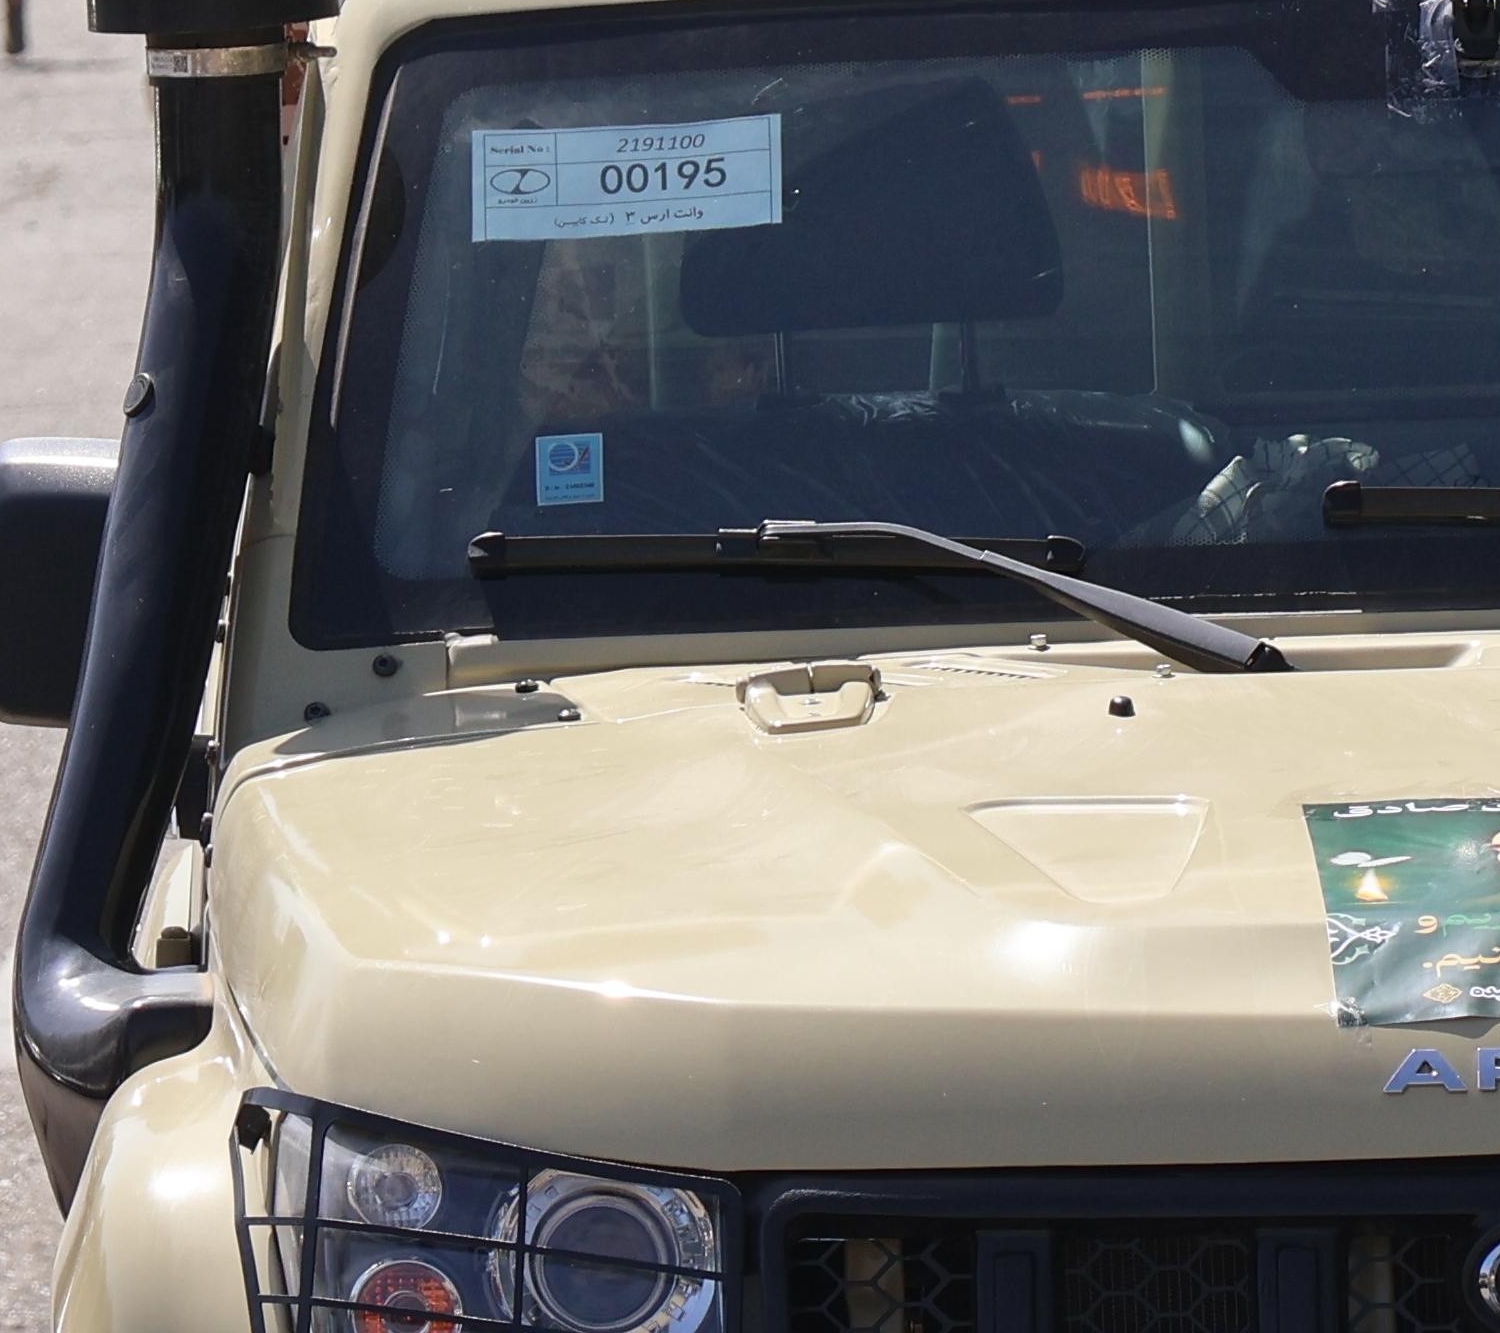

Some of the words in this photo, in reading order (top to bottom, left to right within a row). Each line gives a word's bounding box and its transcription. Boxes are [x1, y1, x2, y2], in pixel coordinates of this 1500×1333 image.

[489, 144, 525, 155] Serial
[615, 133, 705, 154] 2191100
[599, 157, 727, 195] 00195
[640, 208, 671, 225] ارس
[674, 206, 704, 221] وانت
[1333, 801, 1469, 818] صادق
[1414, 914, 1440, 935] و
